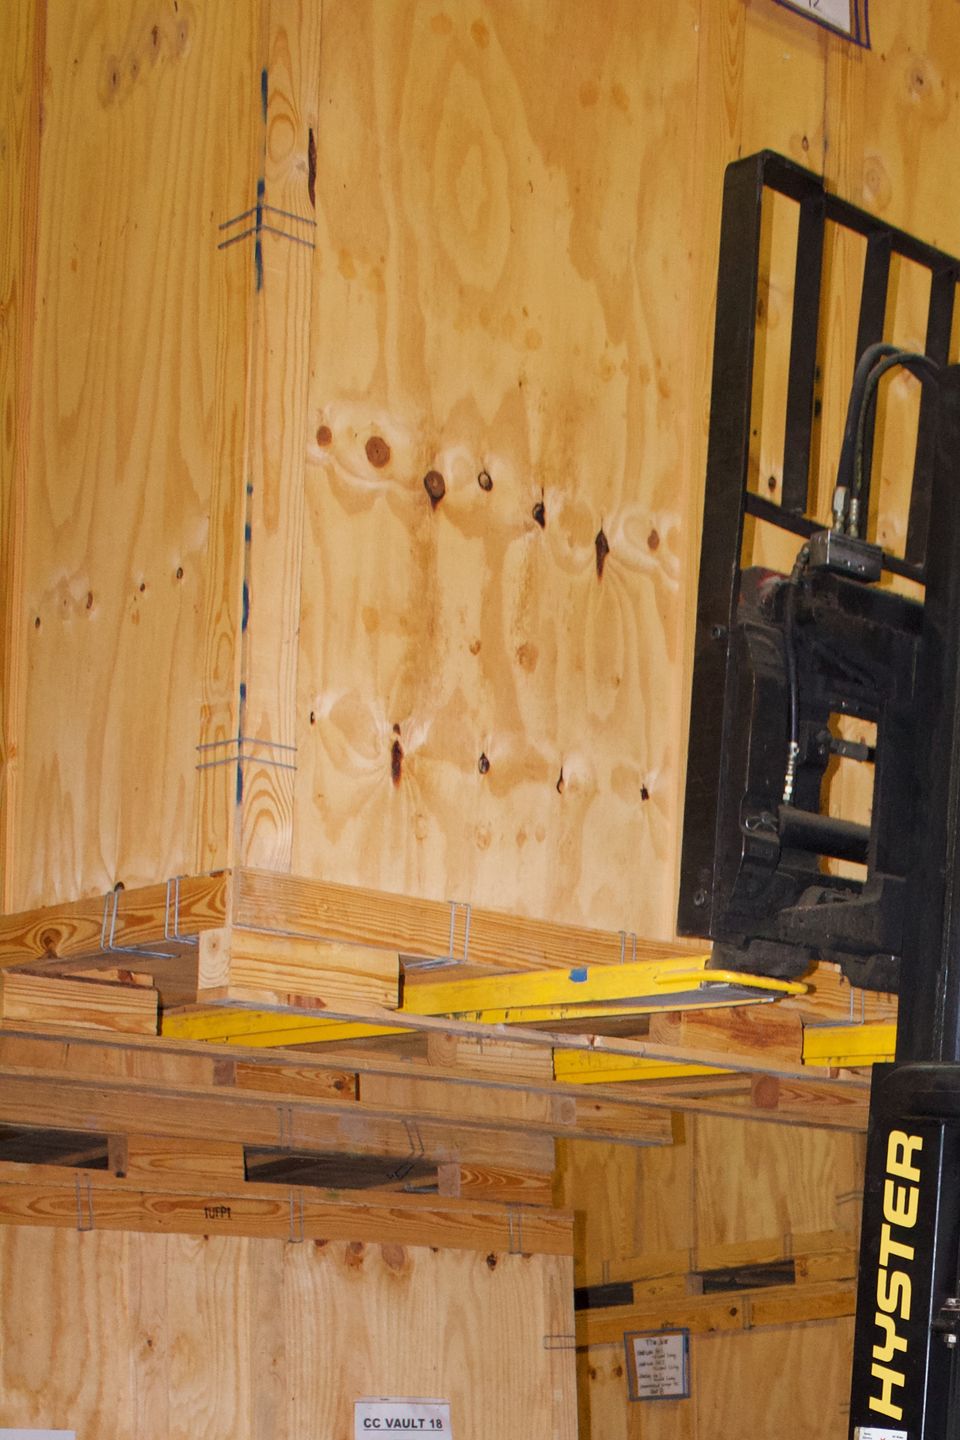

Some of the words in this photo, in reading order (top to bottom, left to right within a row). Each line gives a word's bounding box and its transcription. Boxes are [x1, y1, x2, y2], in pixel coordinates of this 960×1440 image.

[869, 1129, 923, 1421] HYSTER
[363, 1418, 381, 1429] CC
[385, 1418, 425, 1429] VAULT
[429, 1418, 443, 1429] 18
